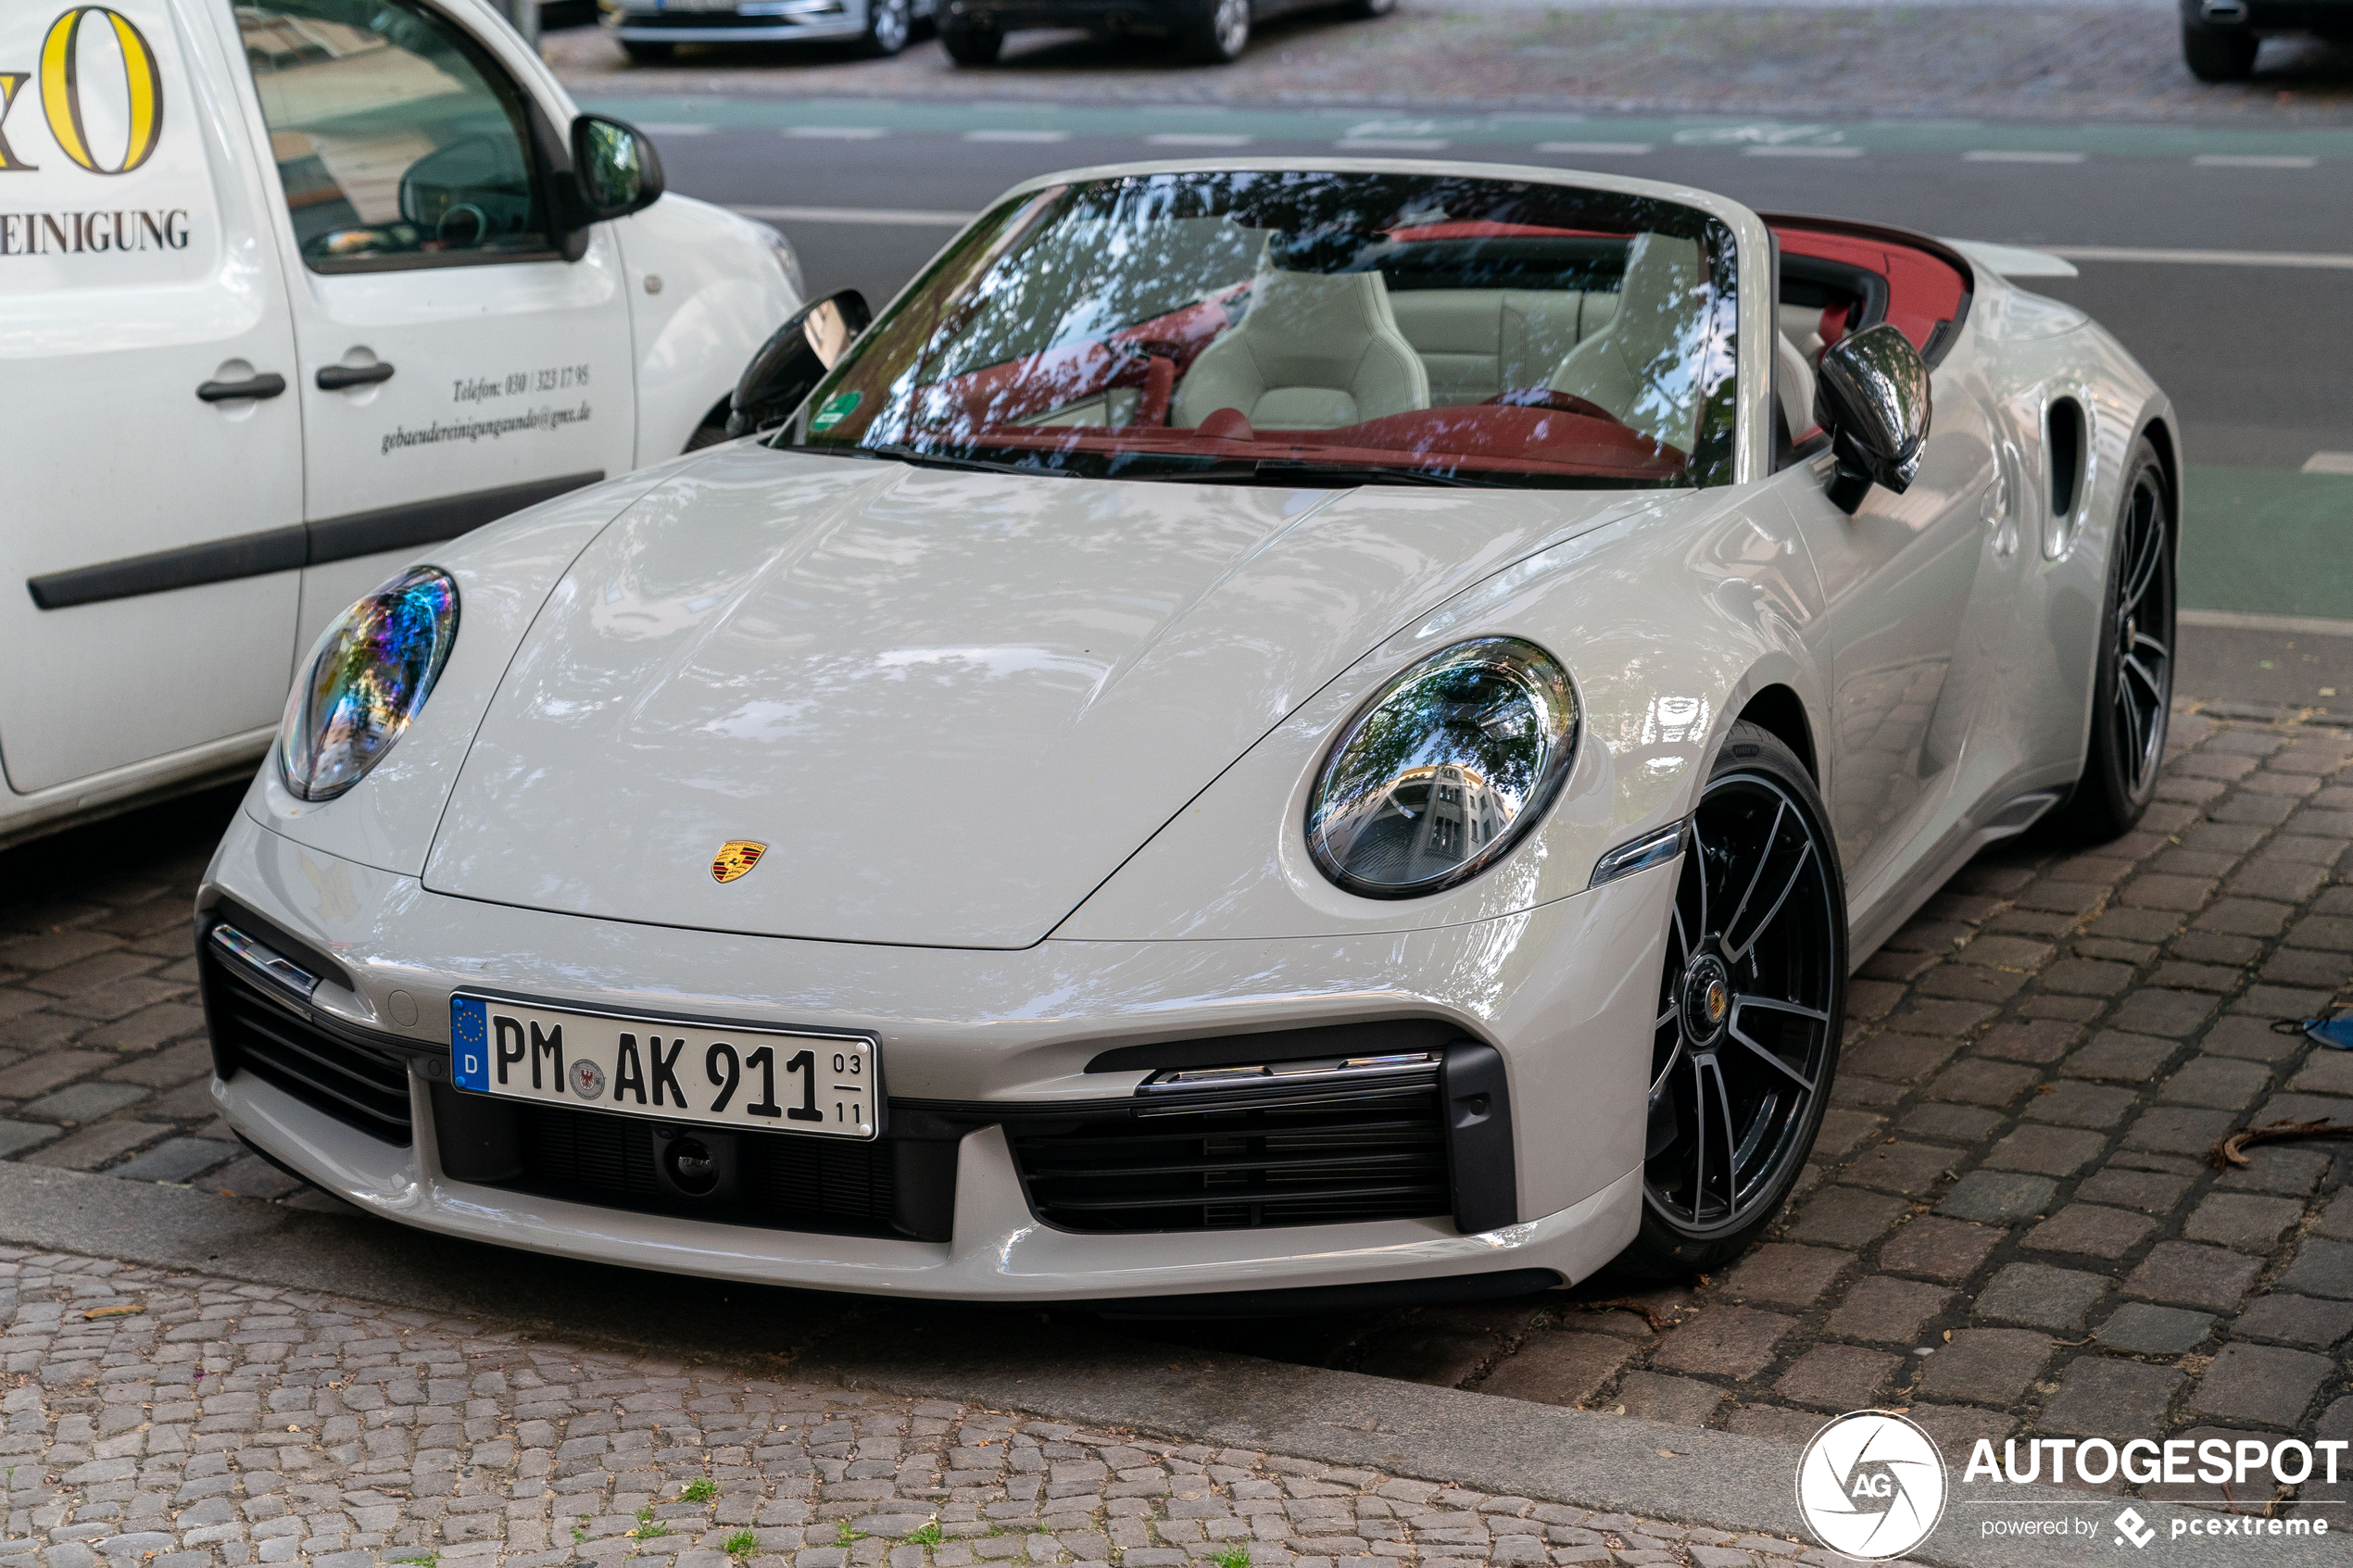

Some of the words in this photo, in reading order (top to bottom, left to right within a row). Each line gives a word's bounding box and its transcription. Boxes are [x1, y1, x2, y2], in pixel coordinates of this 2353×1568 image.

[453, 376, 501, 405] Telefon:
[505, 371, 527, 396] 030
[535, 368, 557, 392] 323
[465, 1054, 478, 1073] D
[493, 1014, 565, 1093] PM
[613, 1033, 688, 1109] AK
[706, 1042, 824, 1123] 911
[834, 1053, 862, 1074] 03
[837, 1102, 860, 1123] 11
